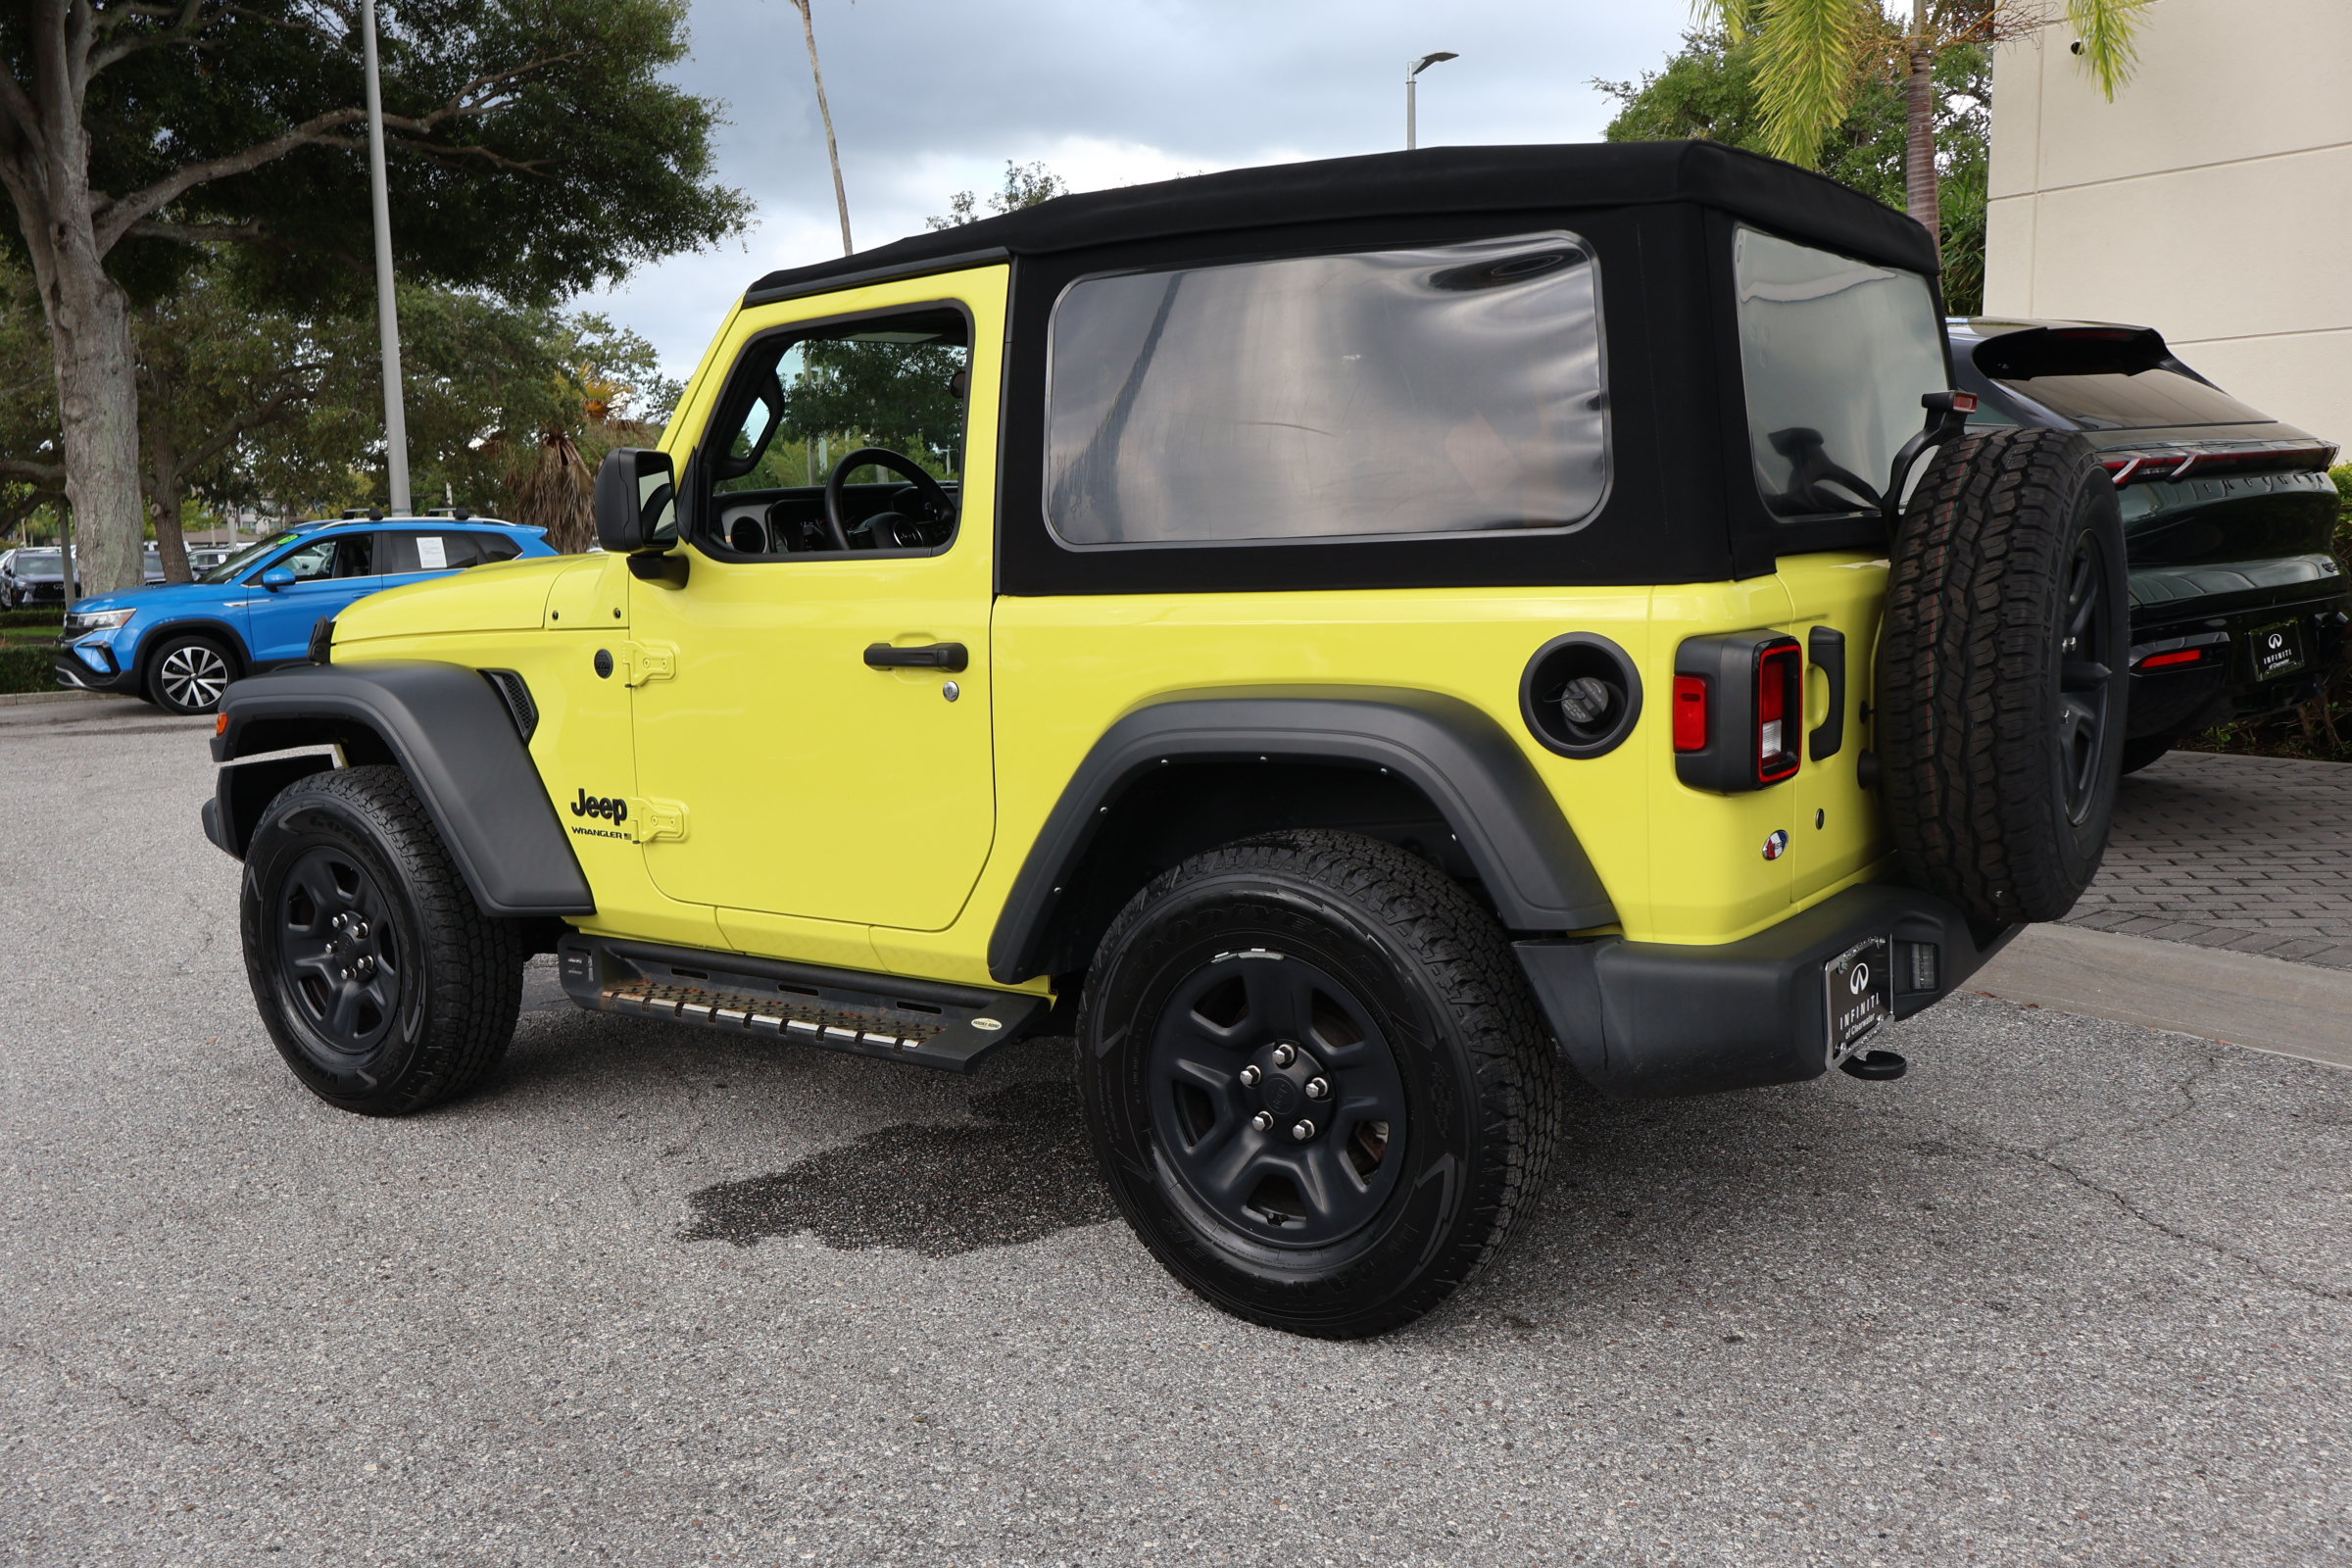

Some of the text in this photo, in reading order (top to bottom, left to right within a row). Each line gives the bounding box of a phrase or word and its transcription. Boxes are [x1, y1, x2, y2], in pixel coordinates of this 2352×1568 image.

[2264, 649, 2292, 664] INFINITI
[570, 788, 627, 826] Jeep
[571, 826, 622, 840] WRANGLER
[1839, 992, 1880, 1030] INFINITI
